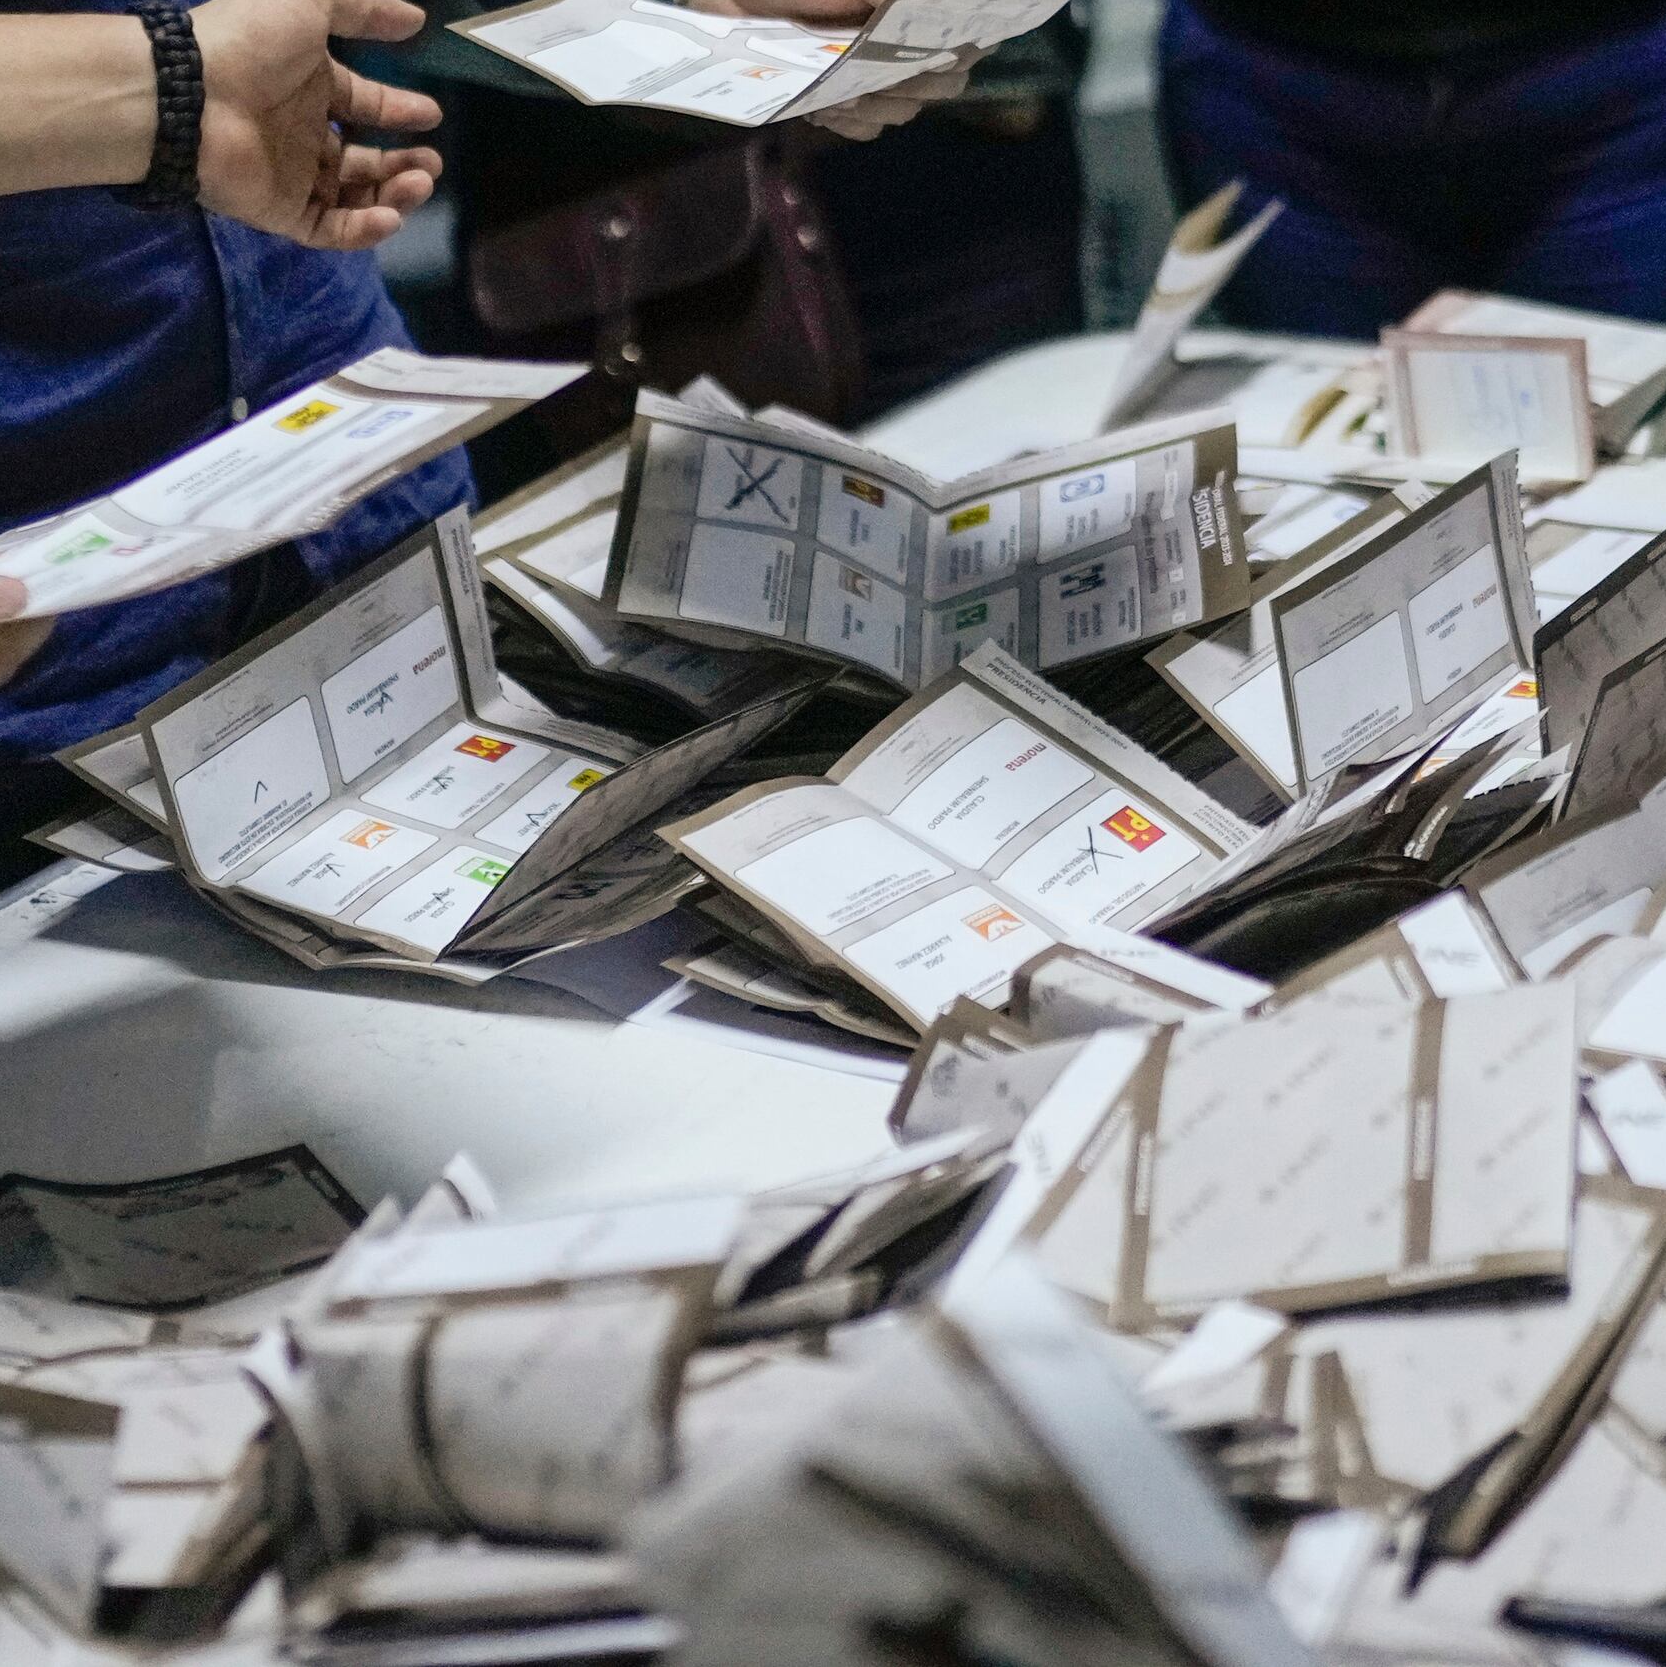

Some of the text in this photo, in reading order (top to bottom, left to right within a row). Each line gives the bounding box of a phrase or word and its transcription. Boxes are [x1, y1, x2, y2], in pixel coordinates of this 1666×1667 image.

[410, 644, 448, 675] morena
[985, 660, 1047, 707] PRESIDENCIA
[1004, 740, 1047, 774] morena
[926, 773, 990, 831] SHEINBAUM PARDO
[954, 793, 986, 822] CLAUDIA
[1108, 804, 1147, 844] PT
[1059, 844, 1097, 878] SEINBAUM
